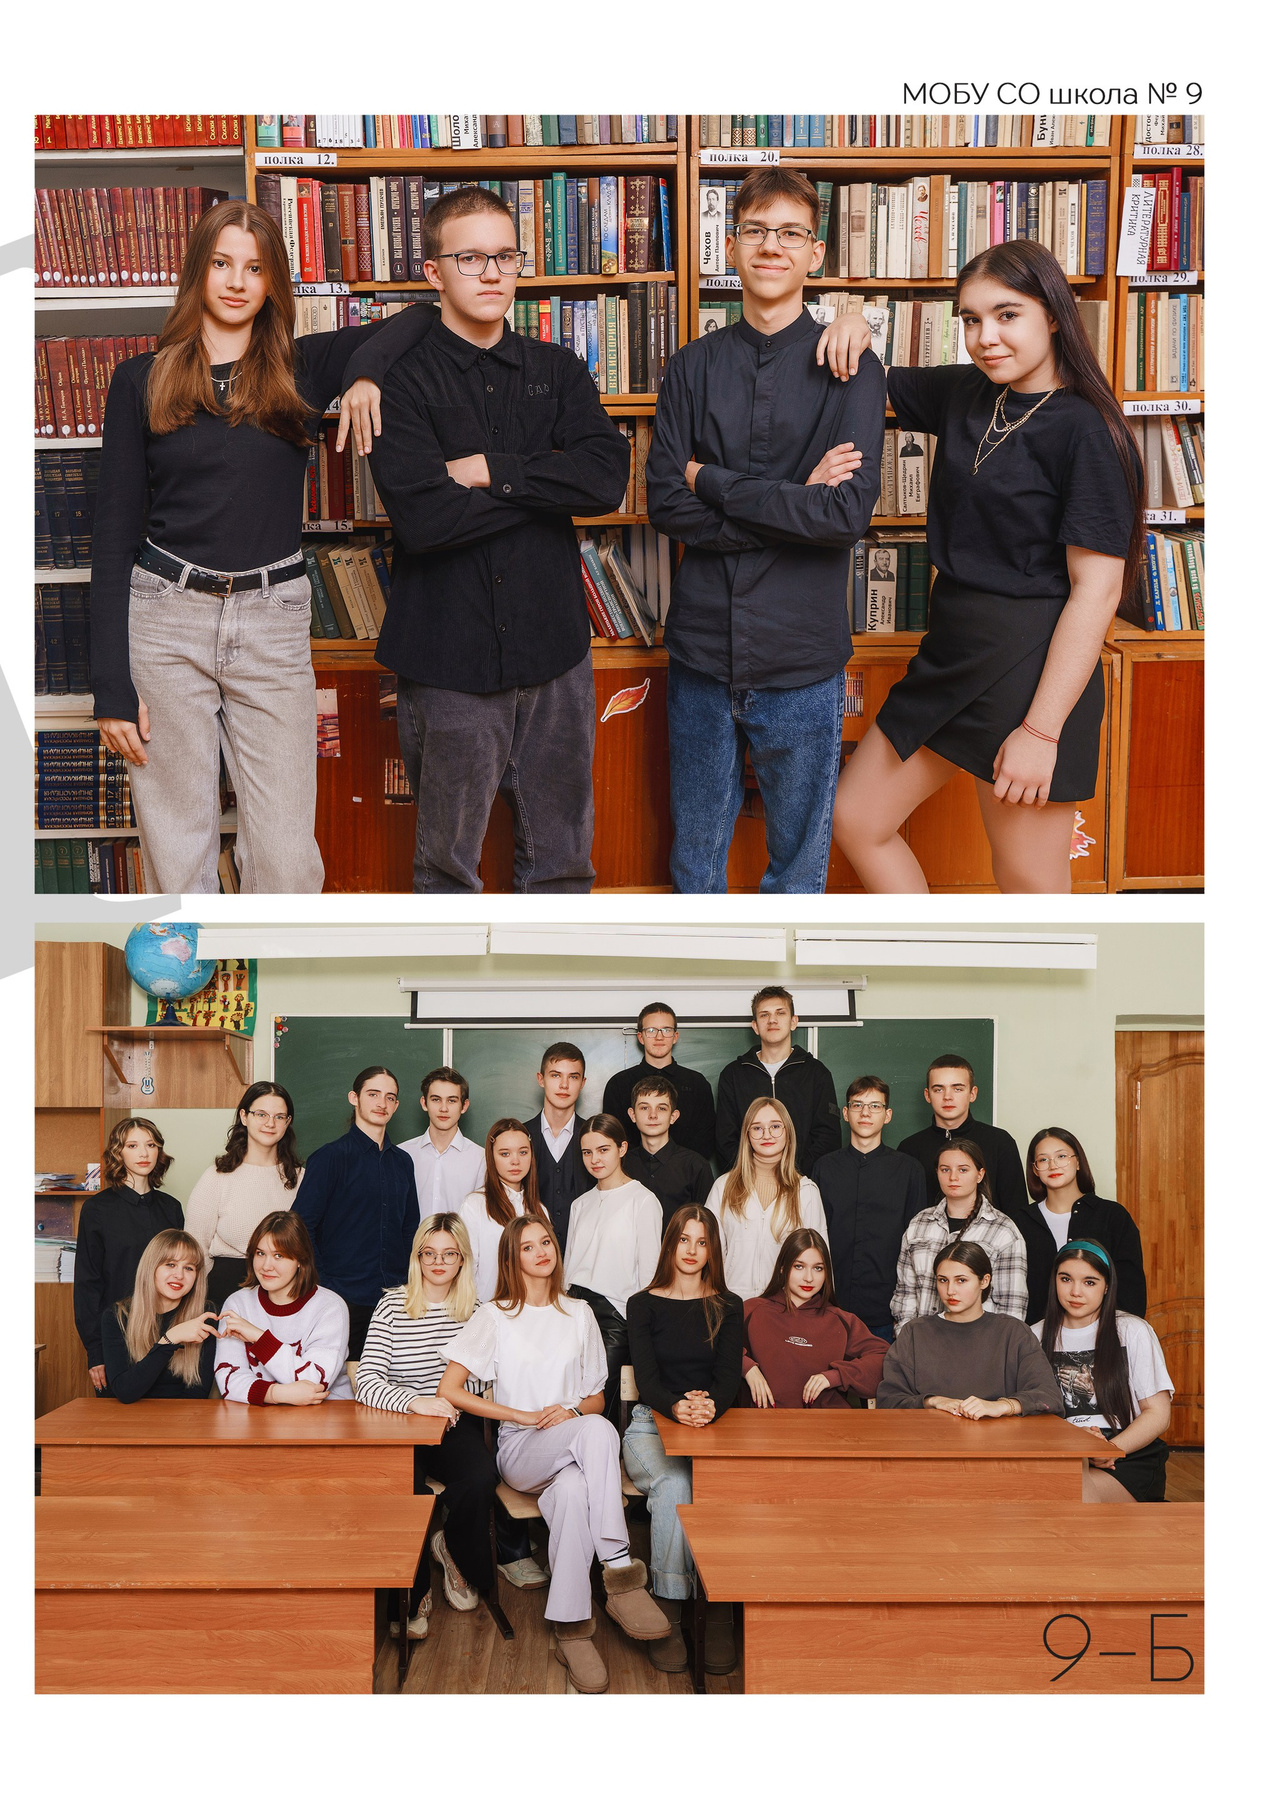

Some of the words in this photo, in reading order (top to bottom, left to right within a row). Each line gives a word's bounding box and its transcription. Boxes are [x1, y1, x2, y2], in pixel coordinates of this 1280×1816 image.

[1142, 147, 1180, 155] полка
[1186, 145, 1202, 156] 28.
[265, 156, 303, 164] полка
[317, 154, 334, 164] 12.
[709, 154, 748, 162] полка
[760, 152, 777, 162] 20.
[1127, 194, 1140, 236] КРИТИКА
[1137, 191, 1153, 265] ЛИТЕРАТУРНАЯ
[604, 233, 608, 241] ПО
[703, 231, 711, 265] Чехов
[1173, 272, 1189, 283] 29.
[330, 283, 347, 293] 13.
[1172, 327, 1177, 336] ПО
[607, 322, 617, 366] ИСТОРИЯ
[608, 369, 617, 388] ВСЯ
[1133, 403, 1169, 412] полка
[1174, 401, 1191, 411] 30.
[1160, 511, 1177, 521] 31.
[334, 520, 351, 531] 15.
[868, 589, 879, 631] Куприн
